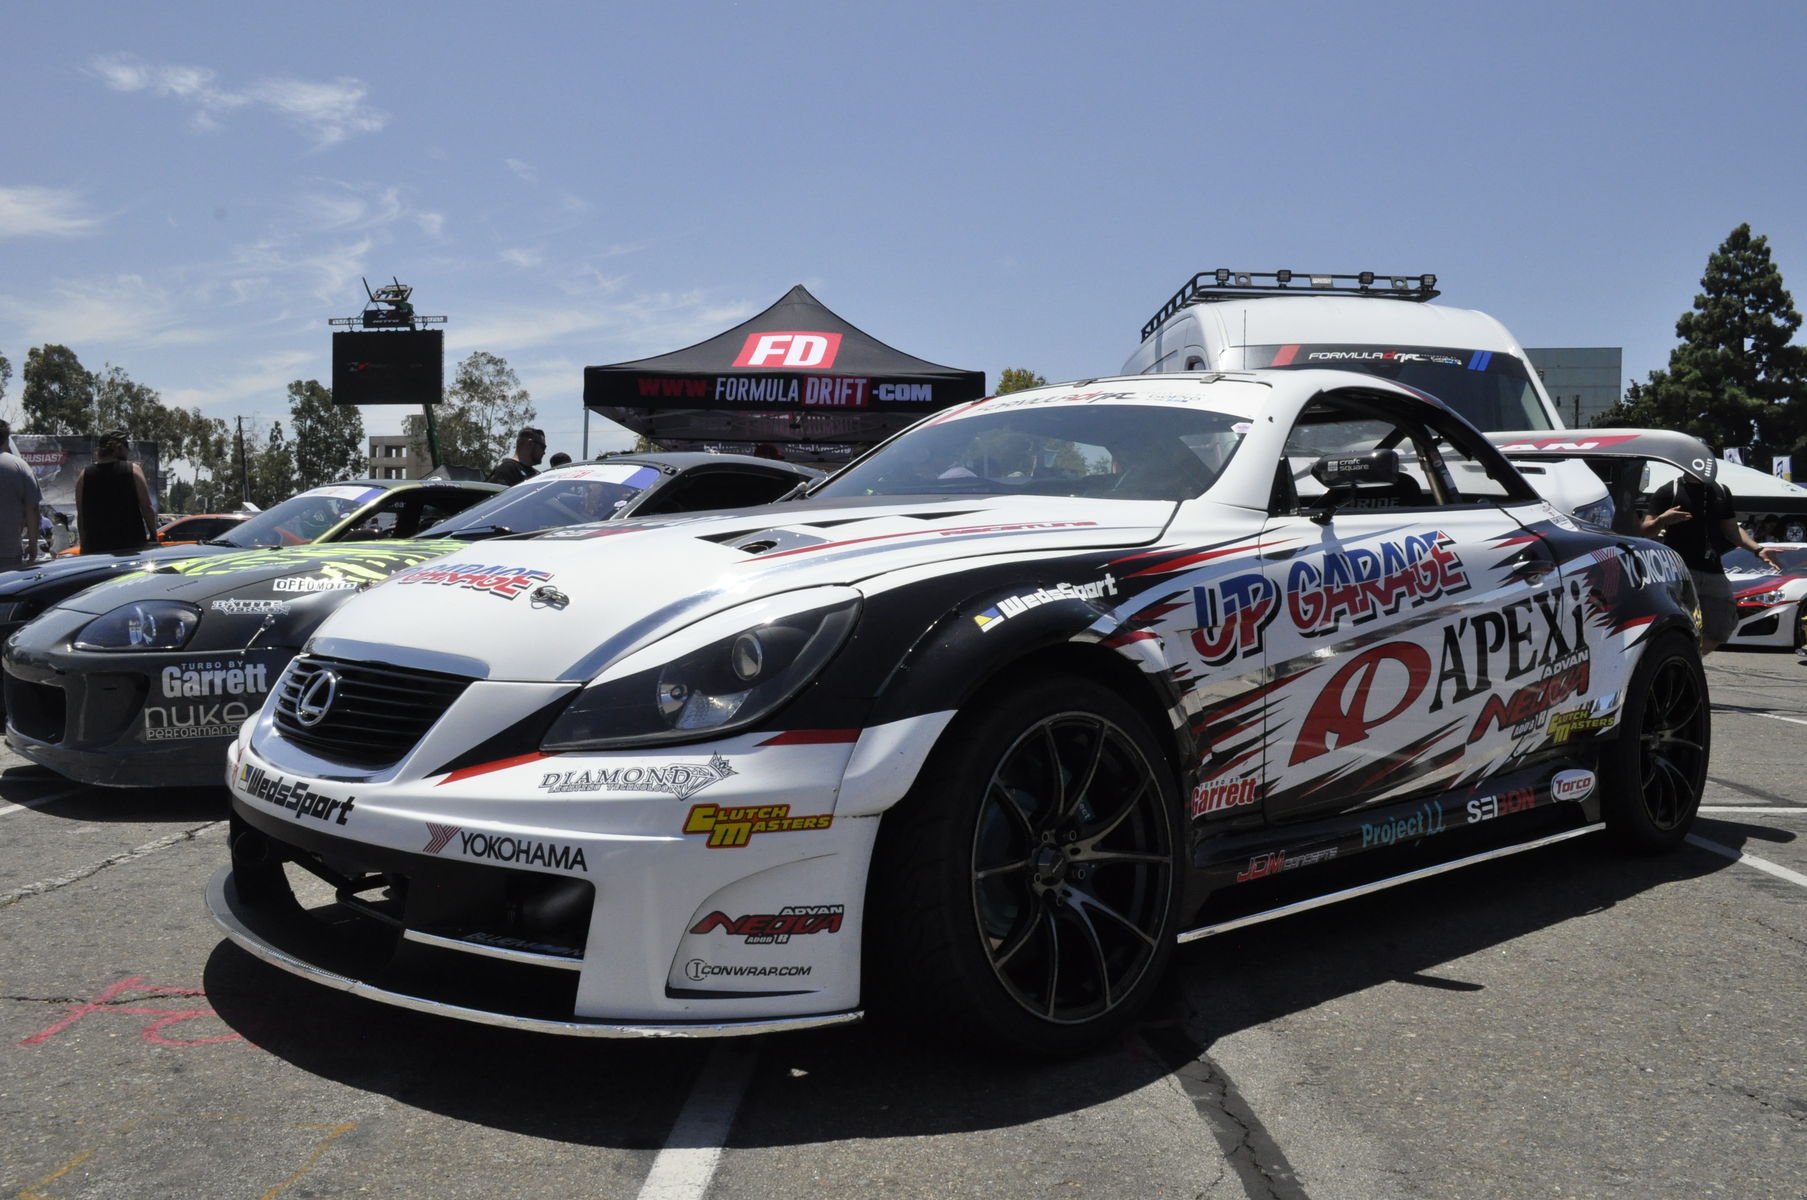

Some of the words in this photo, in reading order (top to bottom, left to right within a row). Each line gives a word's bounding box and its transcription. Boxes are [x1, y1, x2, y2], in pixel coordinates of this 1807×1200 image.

[748, 335, 827, 367] FD
[21, 453, 64, 463] HUSIAST
[1339, 457, 1361, 466] craft
[1339, 464, 1370, 472] square
[211, 598, 283, 610] BATTLE
[996, 573, 1118, 619] WedsSport
[1190, 572, 1283, 668] UP
[1286, 529, 1473, 639] GARAGE
[181, 663, 222, 671] TURBO
[1542, 650, 1590, 680] ADVAN
[162, 663, 267, 699] Garrett
[144, 701, 249, 729] nuke
[146, 724, 242, 741] PERFORMANC
[539, 766, 695, 789] DIAMOND
[1556, 776, 1592, 795] Torco
[247, 765, 355, 826] WedsSport
[1191, 777, 1257, 818] Garrett
[1467, 787, 1537, 824] SEIBON
[684, 805, 790, 834] CLUTCH
[707, 815, 833, 847] MASTERS
[1361, 808, 1424, 849] Project
[460, 831, 588, 872] YOKOHAMA
[1236, 849, 1286, 883] JDM
[689, 910, 843, 935] NEOVA
[780, 905, 844, 916] ADVAN
